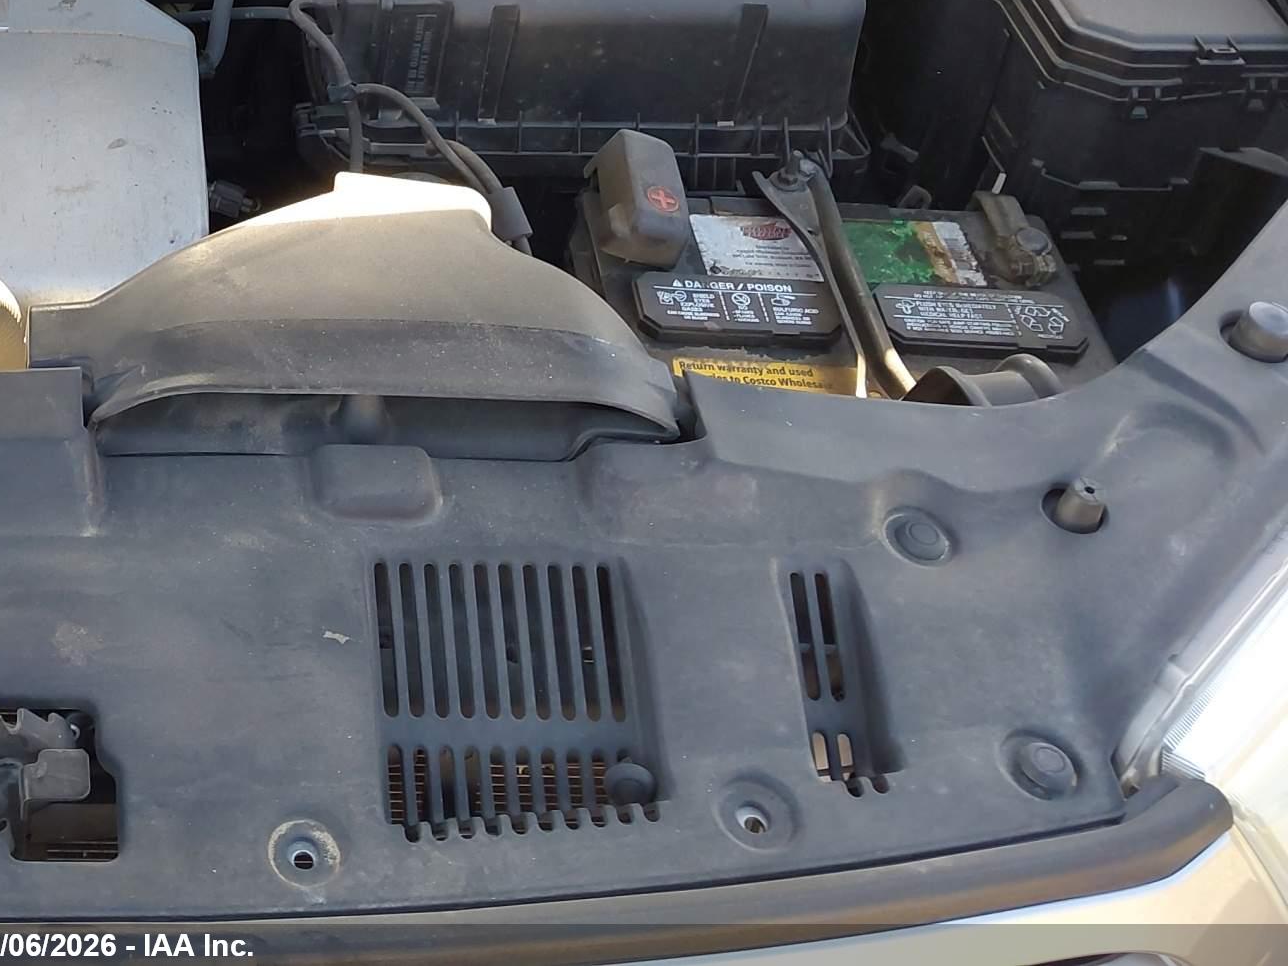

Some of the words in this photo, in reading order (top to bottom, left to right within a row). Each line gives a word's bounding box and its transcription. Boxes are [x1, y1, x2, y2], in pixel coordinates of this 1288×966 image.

[684, 280, 735, 290] DAGER
[746, 283, 793, 293] POISON
[679, 360, 714, 370] Return
[717, 363, 763, 375] warranty
[766, 366, 786, 376] and
[788, 368, 814, 377] used
[743, 376, 778, 386] Costco
